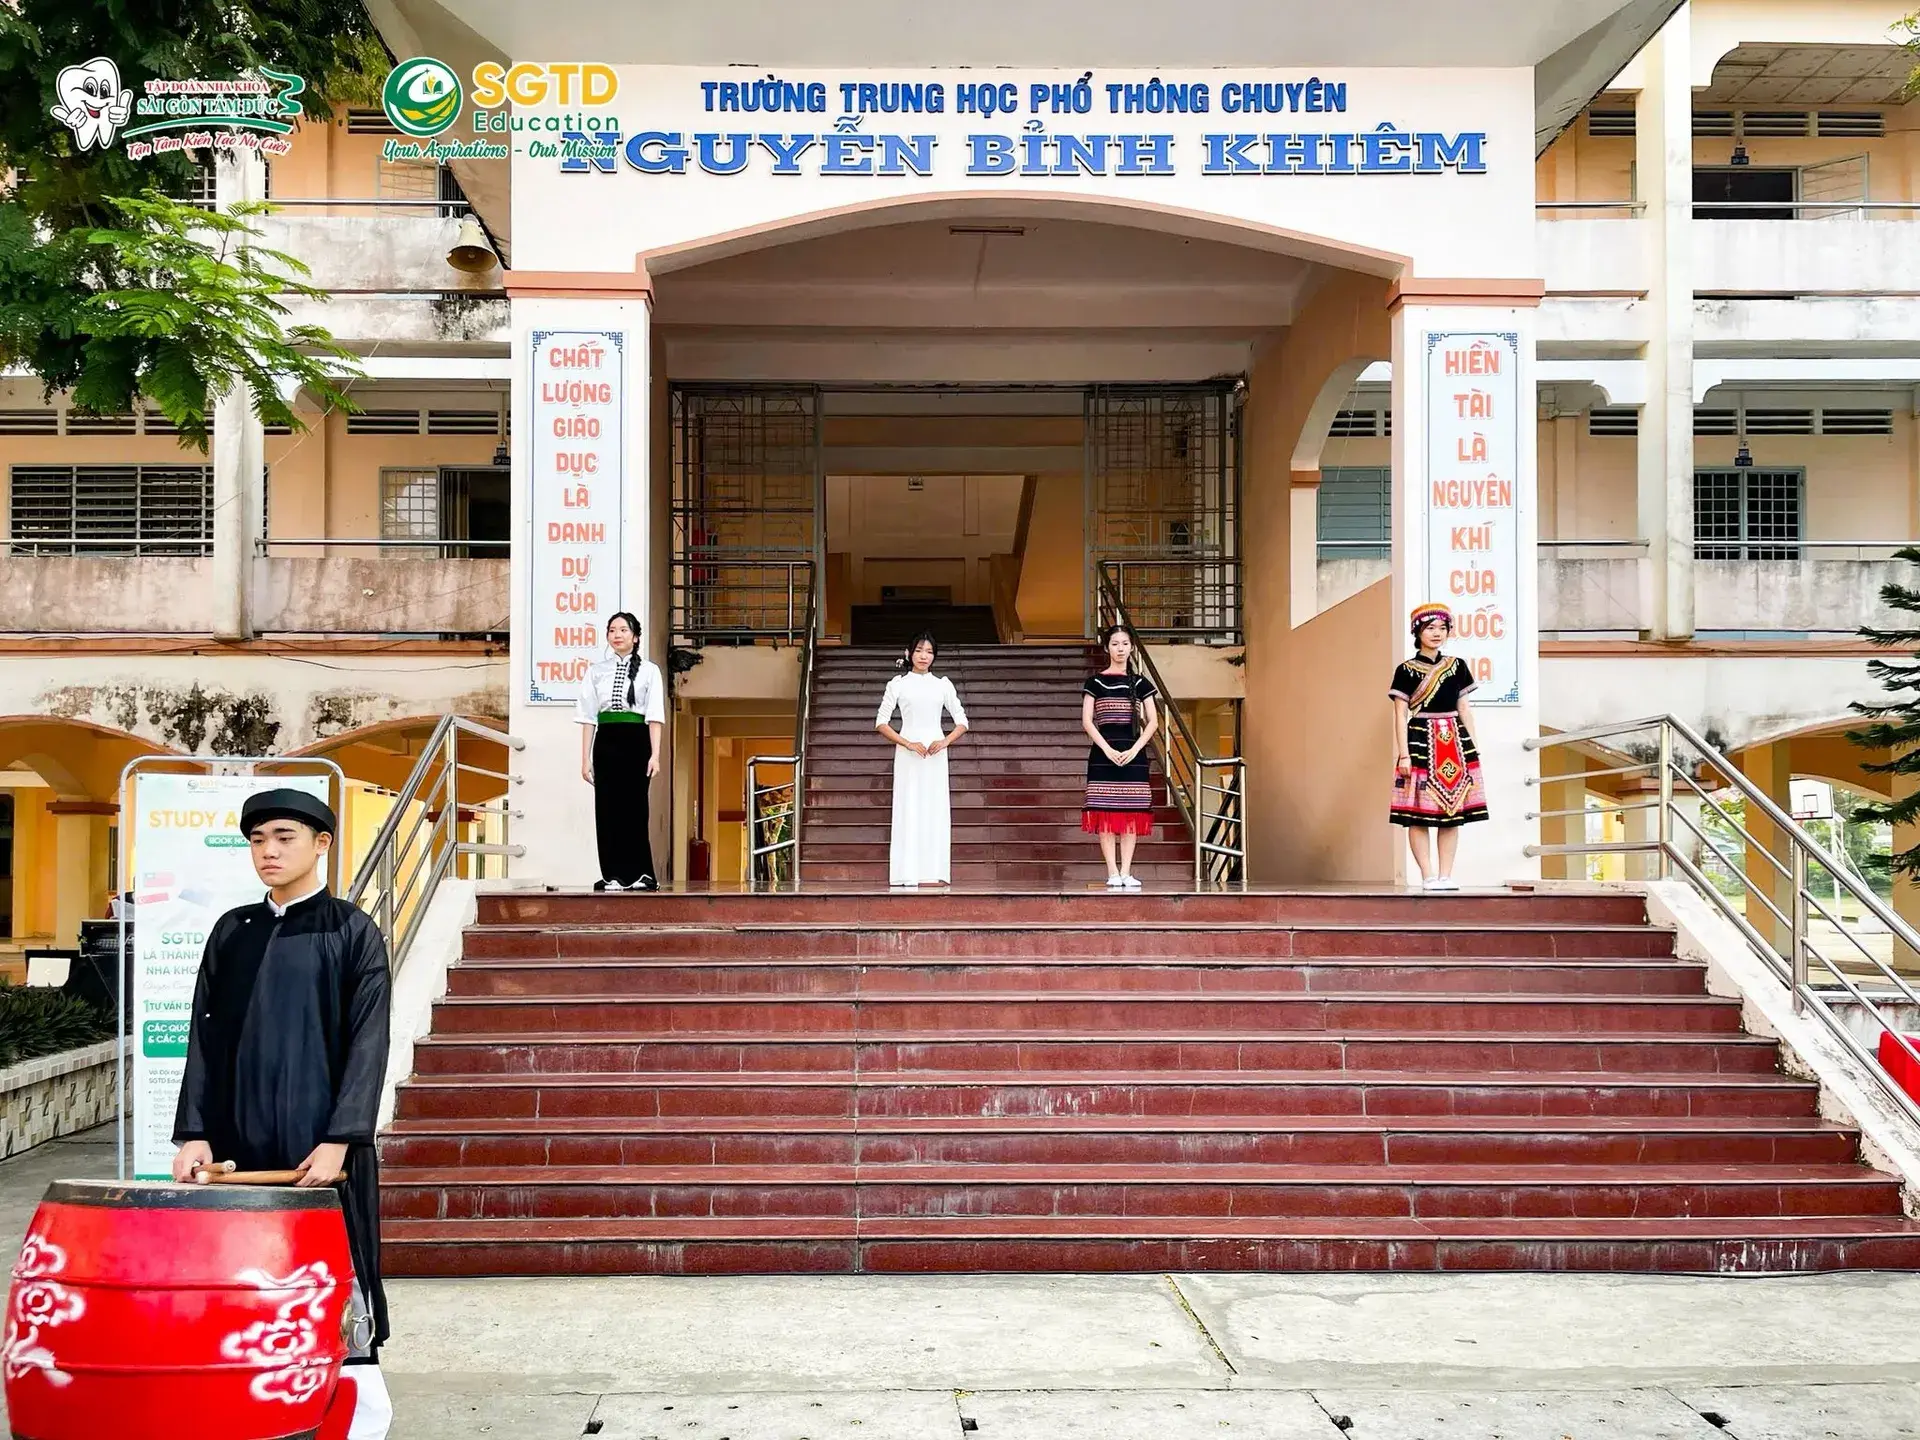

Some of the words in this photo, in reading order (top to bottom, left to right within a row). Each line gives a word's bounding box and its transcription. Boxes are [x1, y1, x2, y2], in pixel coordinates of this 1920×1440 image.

[701, 75, 826, 113] TRƯỜNG
[840, 83, 945, 113] TRUNG
[957, 83, 1018, 118] HỌC
[1030, 71, 1093, 114] PHỔ
[1106, 77, 1209, 114] THÔNG
[1222, 77, 1347, 113] CHUYÊN
[559, 116, 938, 176] NGUYỄN
[965, 119, 1175, 176] BỈNH
[1201, 121, 1488, 176] KHIÊM
[550, 340, 605, 368] CHẤT
[1445, 340, 1500, 375] HIỀN
[542, 380, 612, 407] LƯỢNG
[1453, 388, 1492, 418] TÀI
[553, 413, 601, 438] GIÁO
[1457, 432, 1487, 461] LÀ
[556, 452, 597, 477] DỤC
[563, 483, 589, 507] LÀ
[1433, 472, 1512, 507] NGUYÊN
[548, 522, 604, 542] DANH
[1451, 521, 1494, 550] KHÍ
[561, 554, 591, 582] DỰ
[1450, 560, 1496, 595] CỦA
[555, 584, 597, 612] CỦA
[554, 623, 597, 647] NHÀ
[536, 656, 593, 682] TRƯỜ
[1470, 657, 1492, 681] IA
[150, 810, 218, 829] STUDY
[161, 932, 205, 945] SGTD
[146, 965, 171, 976] NHA
[173, 965, 199, 976] KHO
[147, 1022, 167, 1033] CÁC
[169, 1021, 190, 1033] QUỐ
[156, 1033, 177, 1043] CÁC
